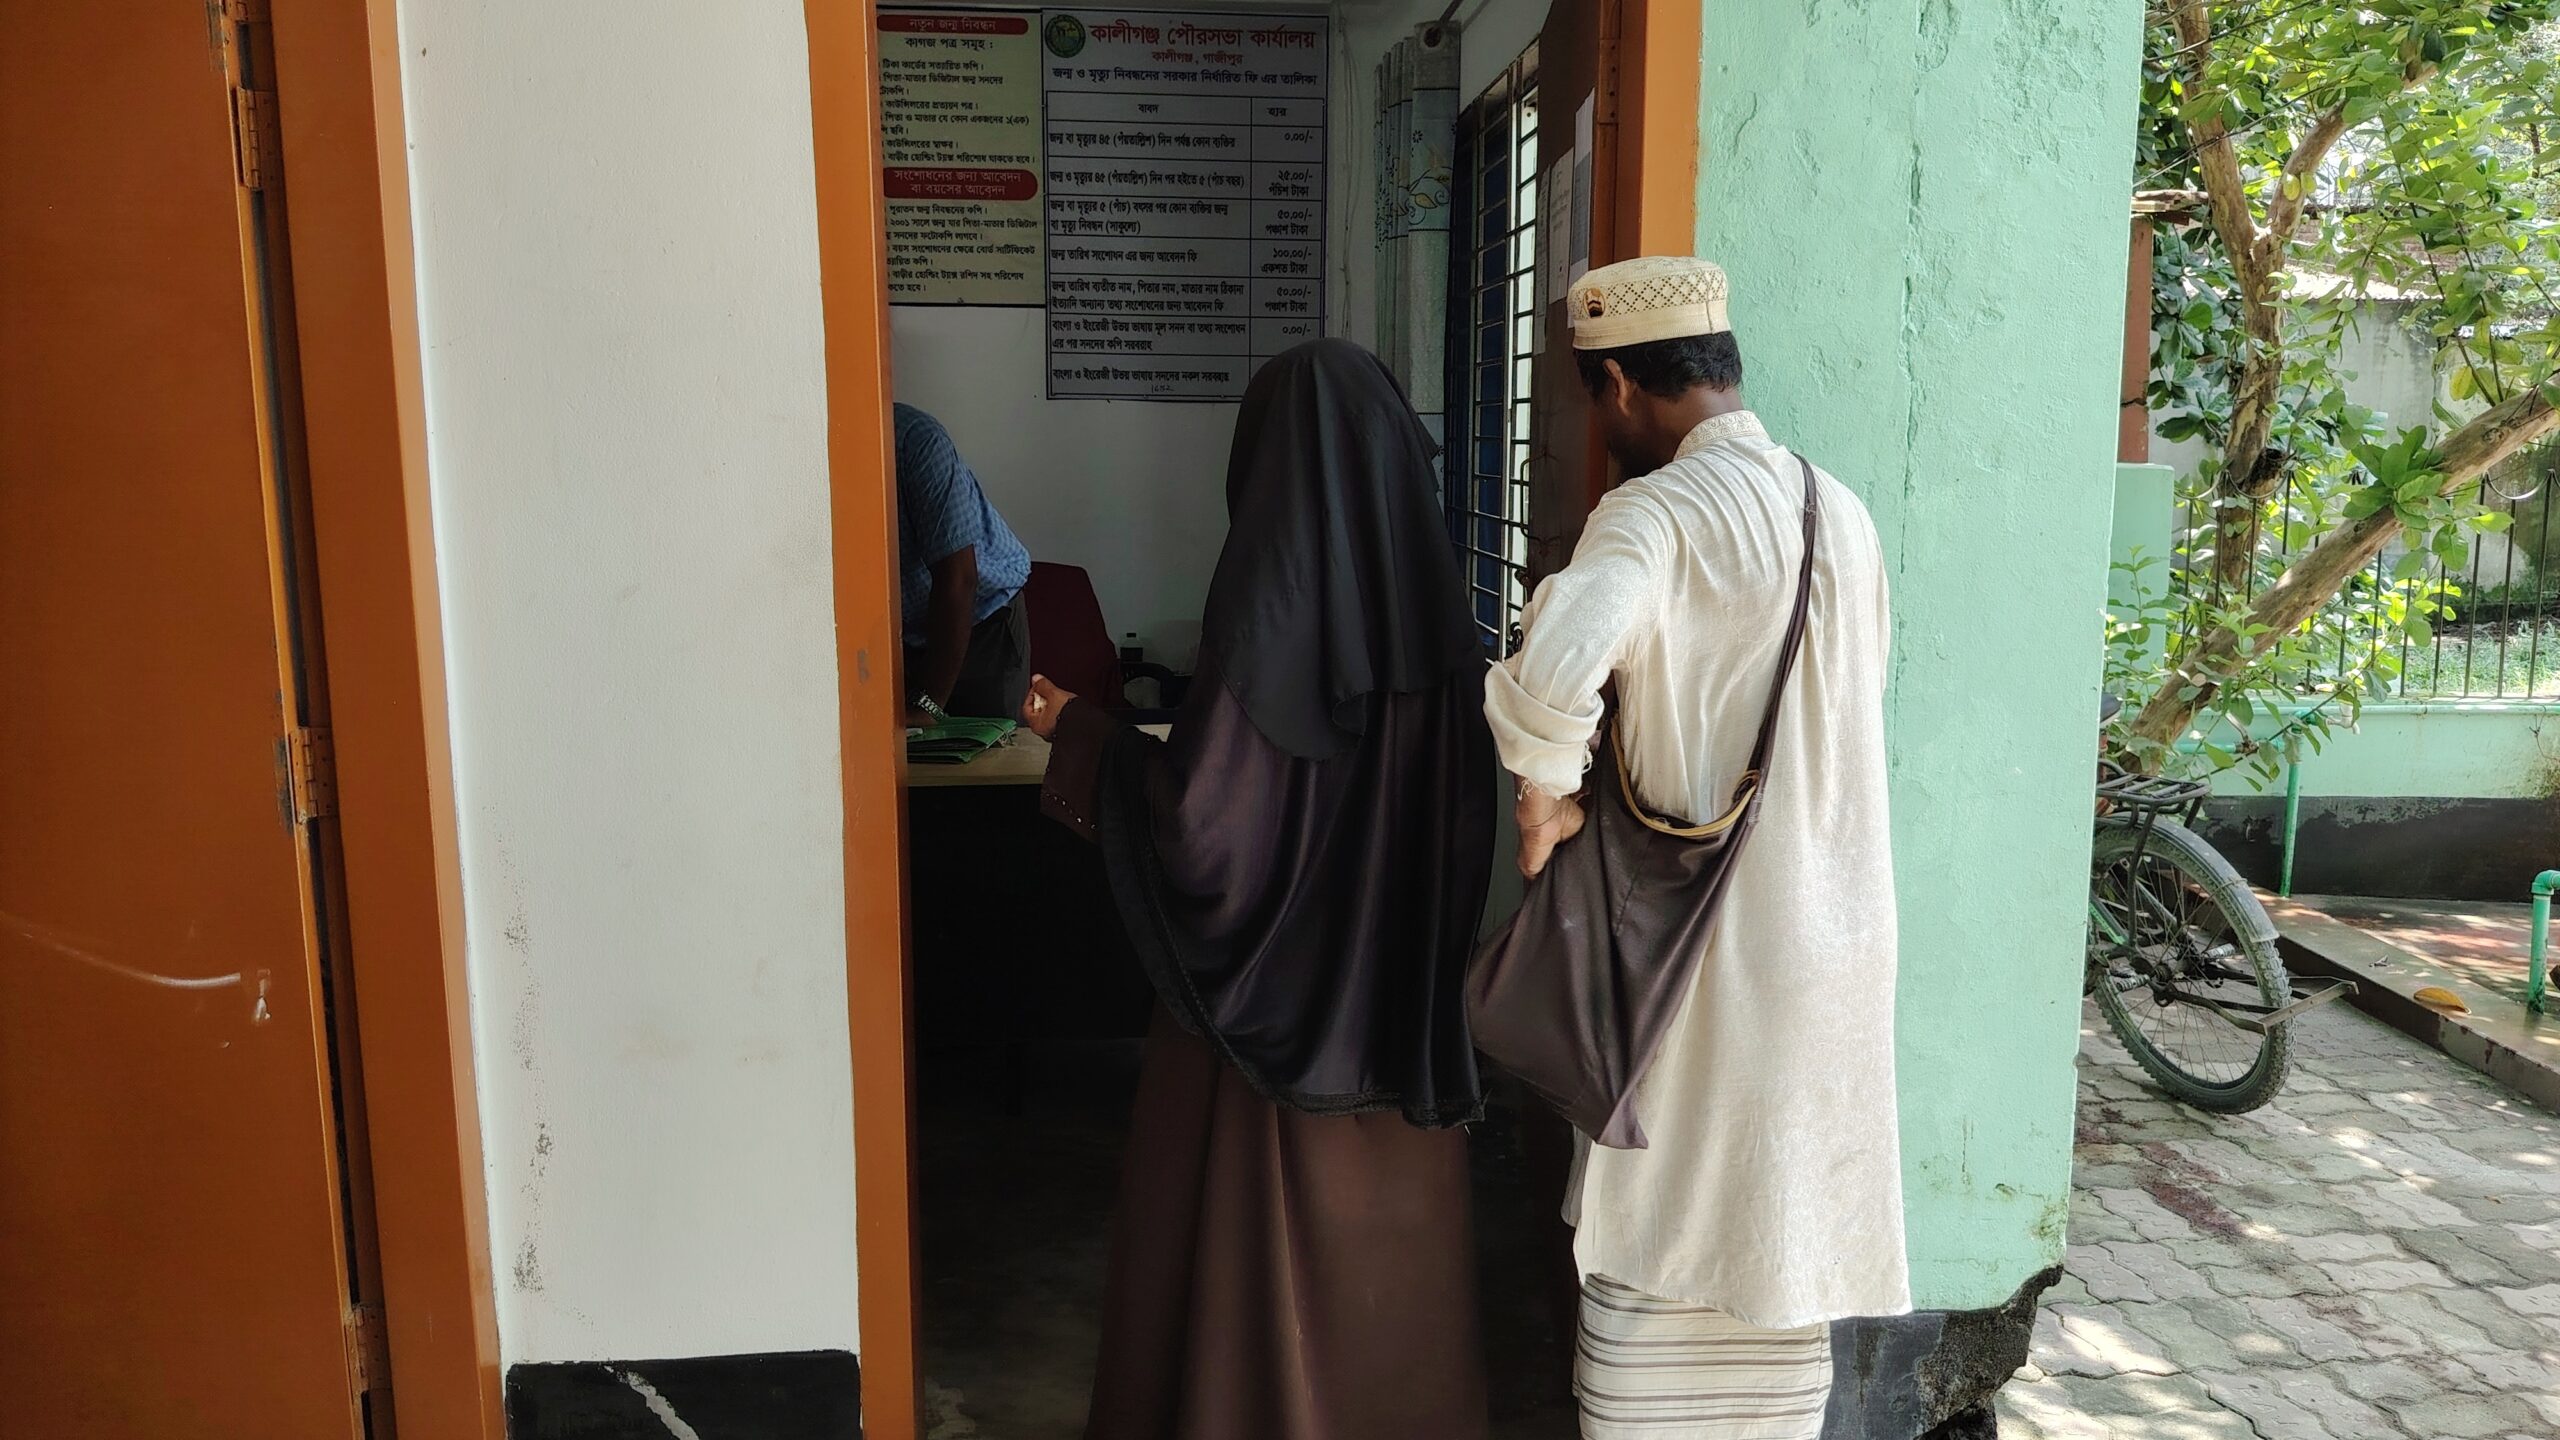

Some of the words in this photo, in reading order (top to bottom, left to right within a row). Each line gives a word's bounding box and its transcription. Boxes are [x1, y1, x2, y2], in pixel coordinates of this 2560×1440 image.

[910, 19, 935, 31] নতুন
[939, 19, 959, 30] জন্ম
[962, 17, 996, 31] নিবন্ধন
[1089, 19, 1160, 44] কালীগঞ্জ
[1167, 20, 1244, 47] পৌরসভা
[1250, 25, 1316, 48] কার্যালয়
[905, 38, 936, 48] কাগজ
[940, 39, 956, 49] পত্র
[1203, 50, 1244, 66] গাজীপুর
[1053, 68, 1073, 79] জন্ম
[1077, 69, 1085, 79] ও
[1089, 68, 1110, 83] মৃত্যু
[1114, 67, 1159, 80] নিবন্ধনের
[1163, 71, 1197, 82] সরকার
[1201, 69, 1240, 83] নির্ধারিত
[1245, 70, 1257, 83] ফি
[1261, 73, 1276, 83] এর
[1282, 72, 1317, 85] তালিকা
[1050, 133, 1063, 144] জন্ম
[1066, 134, 1073, 143] বা
[1099, 134, 1109, 144] ৪৫
[1159, 133, 1171, 145] দিন
[1193, 136, 1210, 146] কোন
[894, 170, 951, 181] সংশোধনের
[956, 172, 976, 181] জন্য
[981, 172, 1021, 182] আবেদন
[1050, 172, 1063, 182] জন্ম
[1066, 172, 1071, 182] ও
[1095, 172, 1104, 183] ৪৫
[1150, 171, 1162, 183] দিন
[1165, 174, 1174, 183] পর
[912, 185, 920, 193] বা
[926, 185, 961, 194] বয়সের
[965, 185, 1005, 197] আবেদন
[1291, 184, 1309, 197] টাকা
[917, 206, 929, 214] জন্ম
[1051, 201, 1064, 212] জন্ম
[1068, 201, 1074, 211] বা
[1100, 202, 1105, 212] ৫
[1156, 203, 1166, 213] পর
[1169, 203, 1186, 214] কোন
[1214, 205, 1228, 215] জন্ম
[912, 219, 929, 227] সালে
[1051, 220, 1058, 230] বা
[1079, 218, 1103, 232] নিবন্ধন
[1291, 223, 1308, 235] টাকা
[1052, 250, 1065, 260] জন্ম
[1092, 251, 1123, 262] সংশোধন
[1126, 252, 1137, 262] এর
[1139, 252, 1154, 262] জন্য
[1157, 253, 1185, 263] আবেদন
[1188, 249, 1197, 263] ফি
[1290, 261, 1307, 274] টাকা
[981, 272, 991, 280] সহ
[1052, 281, 1065, 292] জন্ম
[1138, 280, 1159, 294] পিতার
[1181, 285, 1203, 294] মাতার
[1205, 285, 1218, 294] নাম
[1220, 281, 1244, 295] ঠিকানা
[1167, 301, 1181, 311] জন্য
[1184, 302, 1212, 312] আবেদন
[1215, 299, 1224, 312] ফি
[1290, 300, 1307, 312] টাকা
[1053, 321, 1071, 331] বাংলা
[1074, 322, 1080, 331] ও
[1169, 324, 1184, 333] সনদ
[1188, 324, 1195, 333] বা
[1215, 325, 1246, 334] সংশোধন
[1053, 339, 1064, 348] এর
[1066, 339, 1077, 348] পর
[1080, 340, 1105, 349] সনদের
[1107, 337, 1121, 350] কপি
[1053, 369, 1072, 380] বাংলা
[1075, 371, 1080, 379] ও
